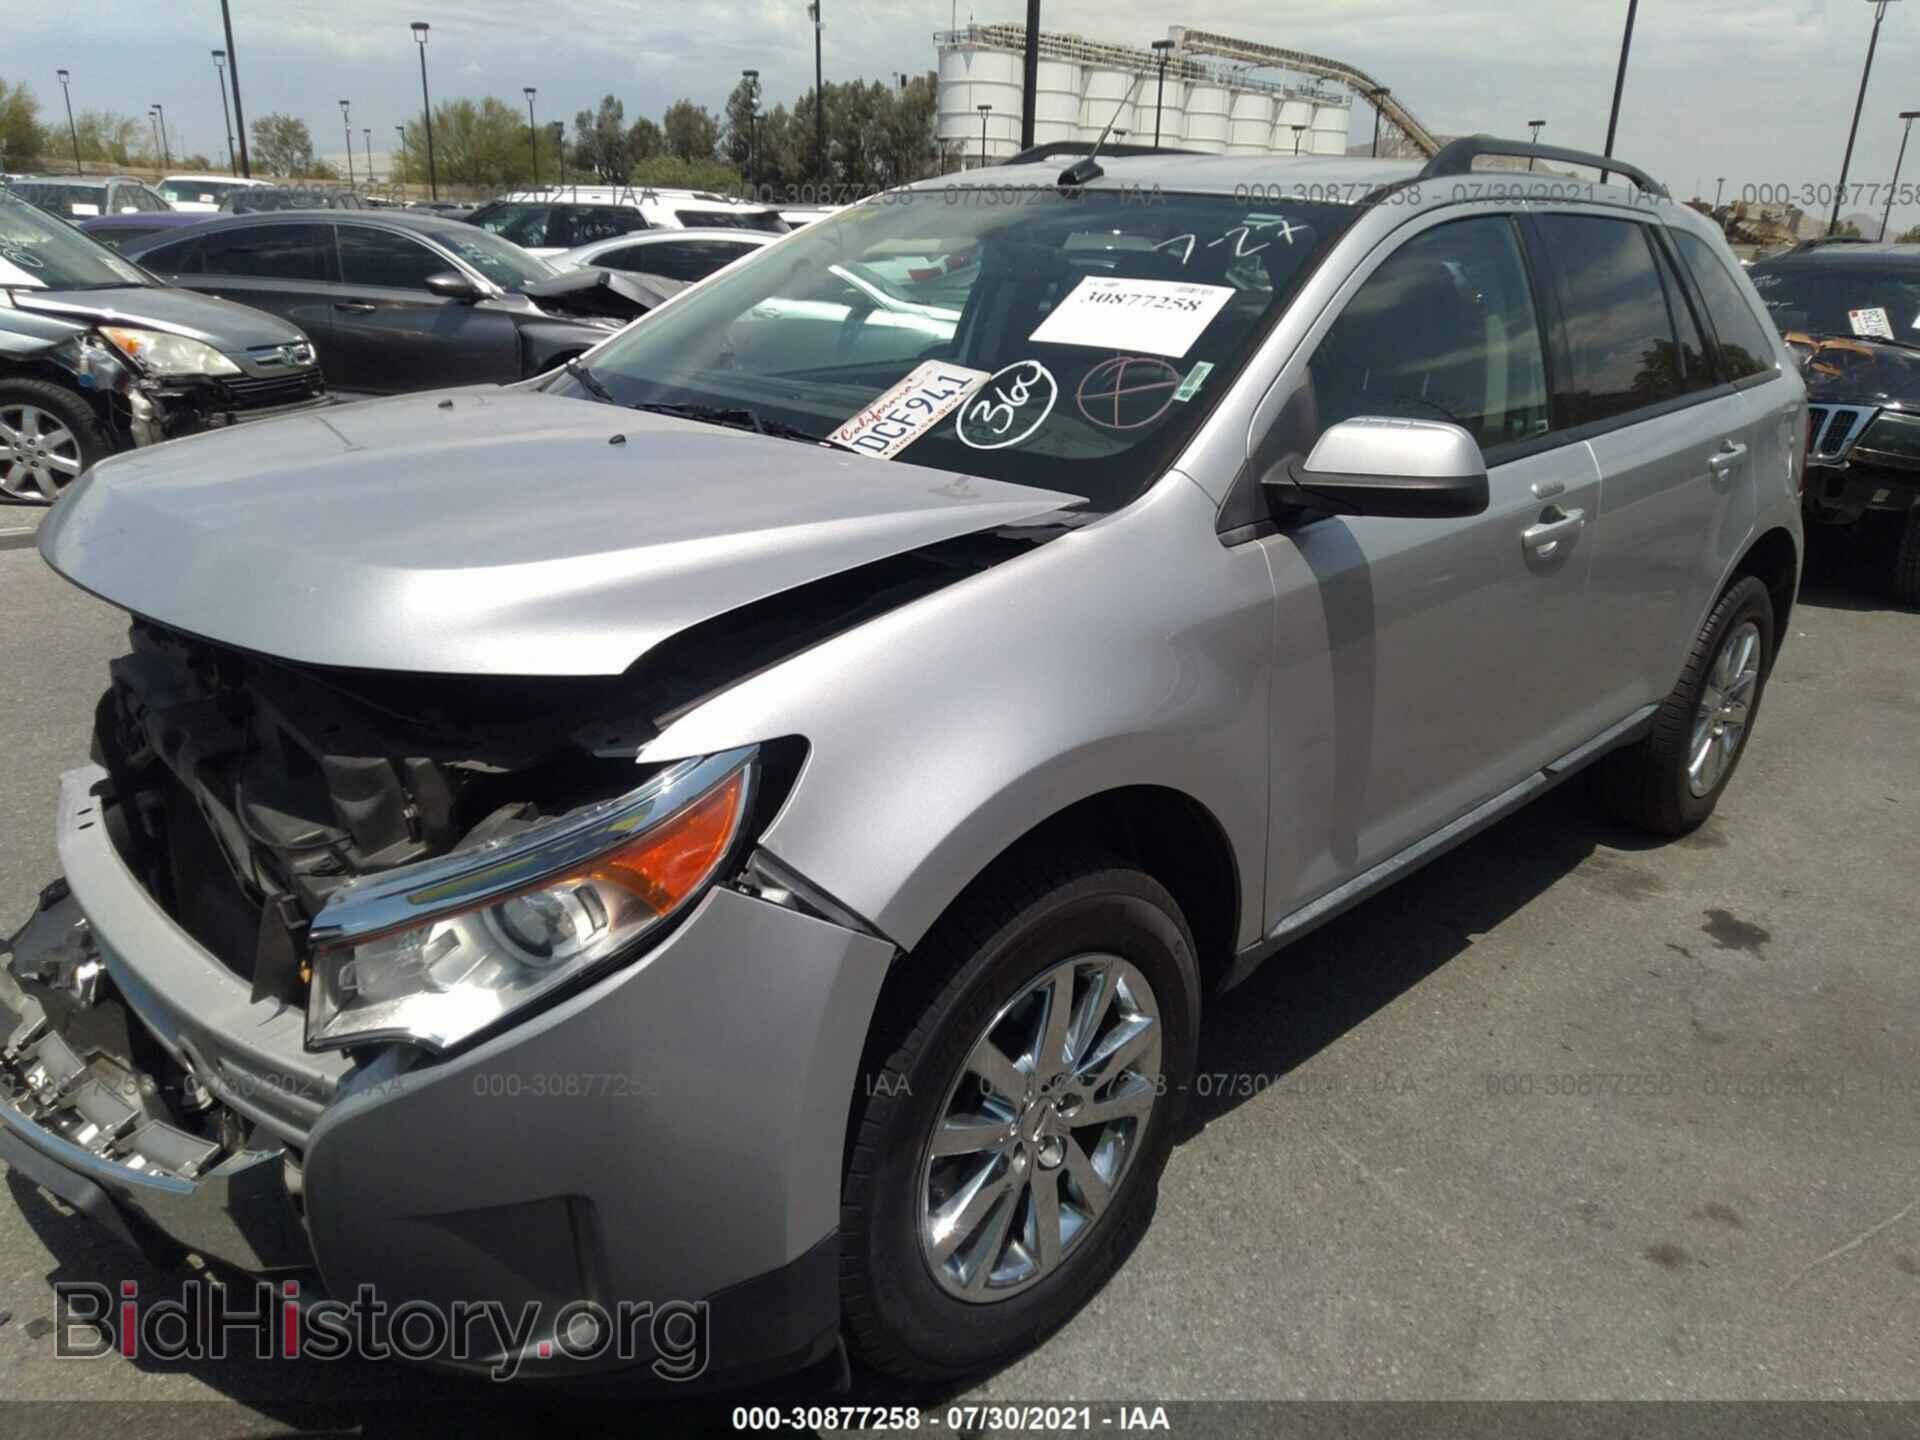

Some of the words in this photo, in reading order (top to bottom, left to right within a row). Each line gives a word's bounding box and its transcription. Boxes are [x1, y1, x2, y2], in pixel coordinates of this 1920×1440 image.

[1080, 290, 1202, 312] 30877258
[840, 383, 914, 441] California
[852, 375, 974, 453] DCF941
